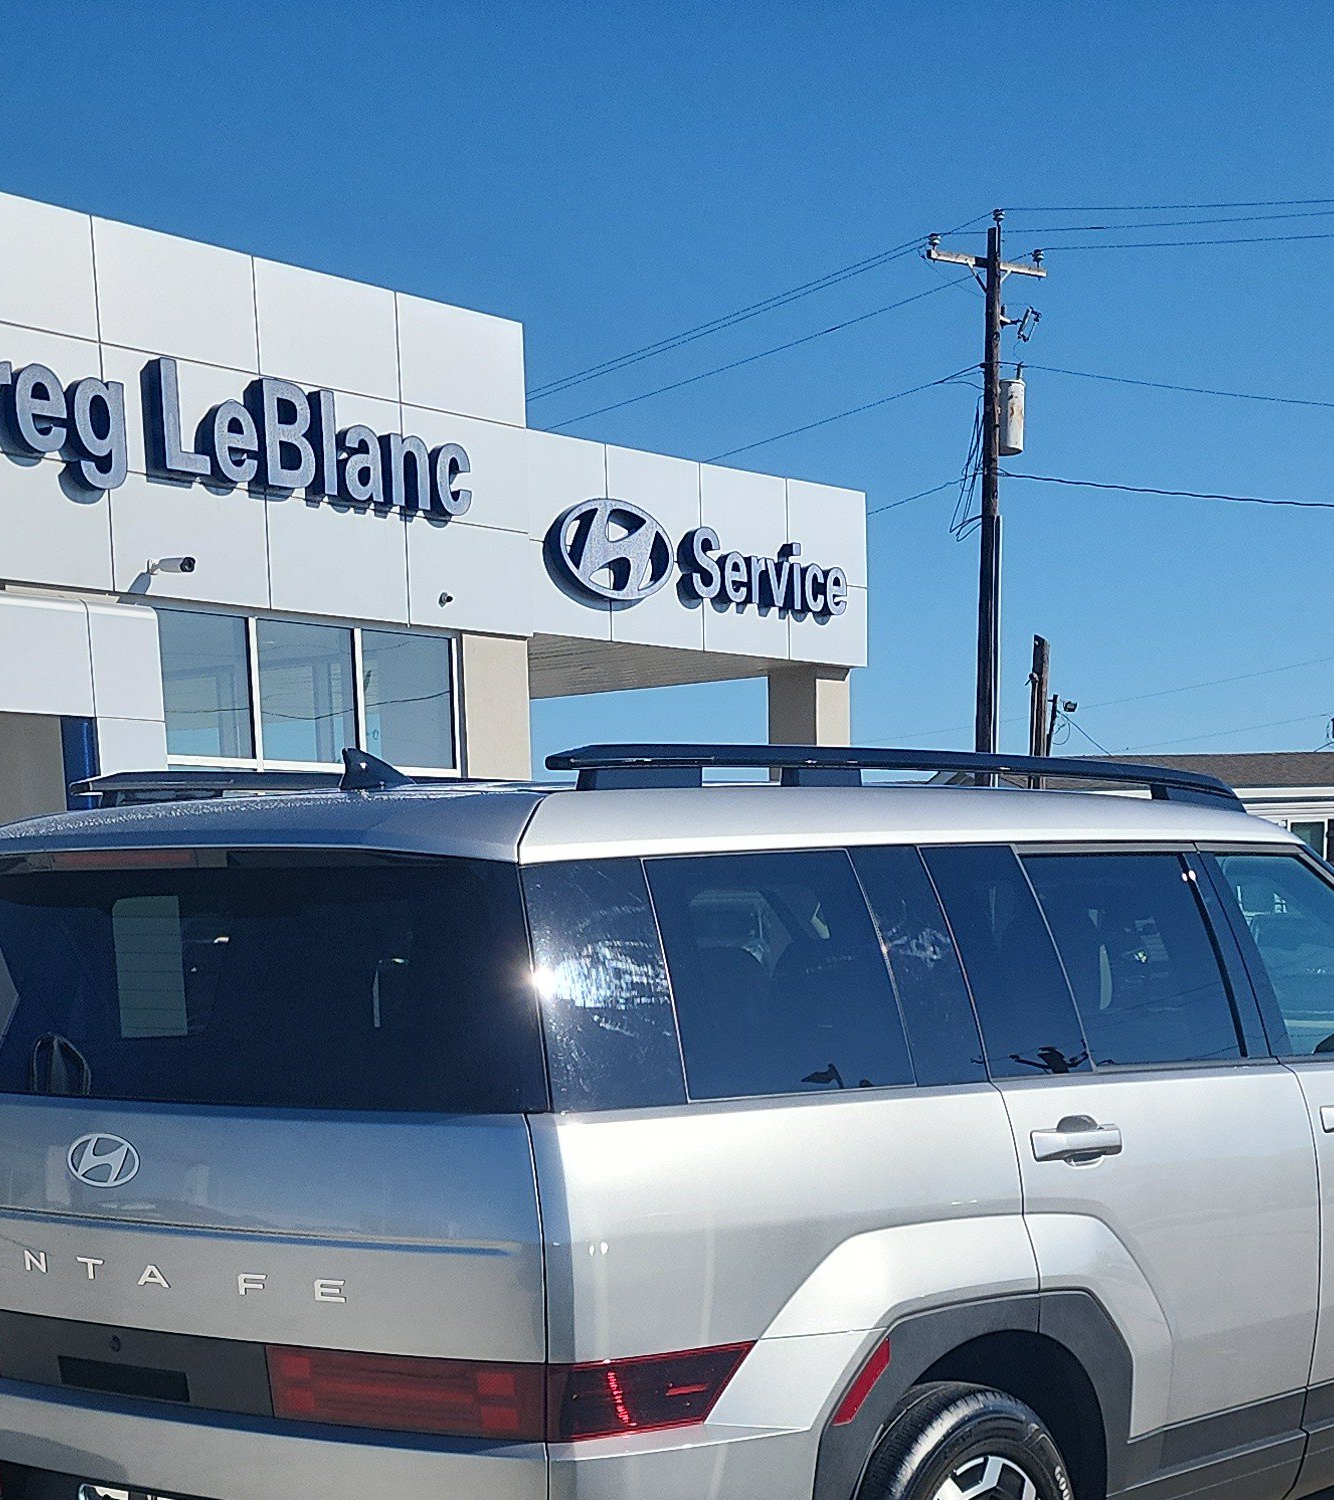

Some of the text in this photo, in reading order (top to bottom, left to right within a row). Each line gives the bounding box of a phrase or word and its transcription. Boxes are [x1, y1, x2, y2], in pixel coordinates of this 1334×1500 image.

[140, 357, 472, 517] LeBlanc
[678, 527, 847, 616] Service
[237, 1273, 347, 1303] FE
